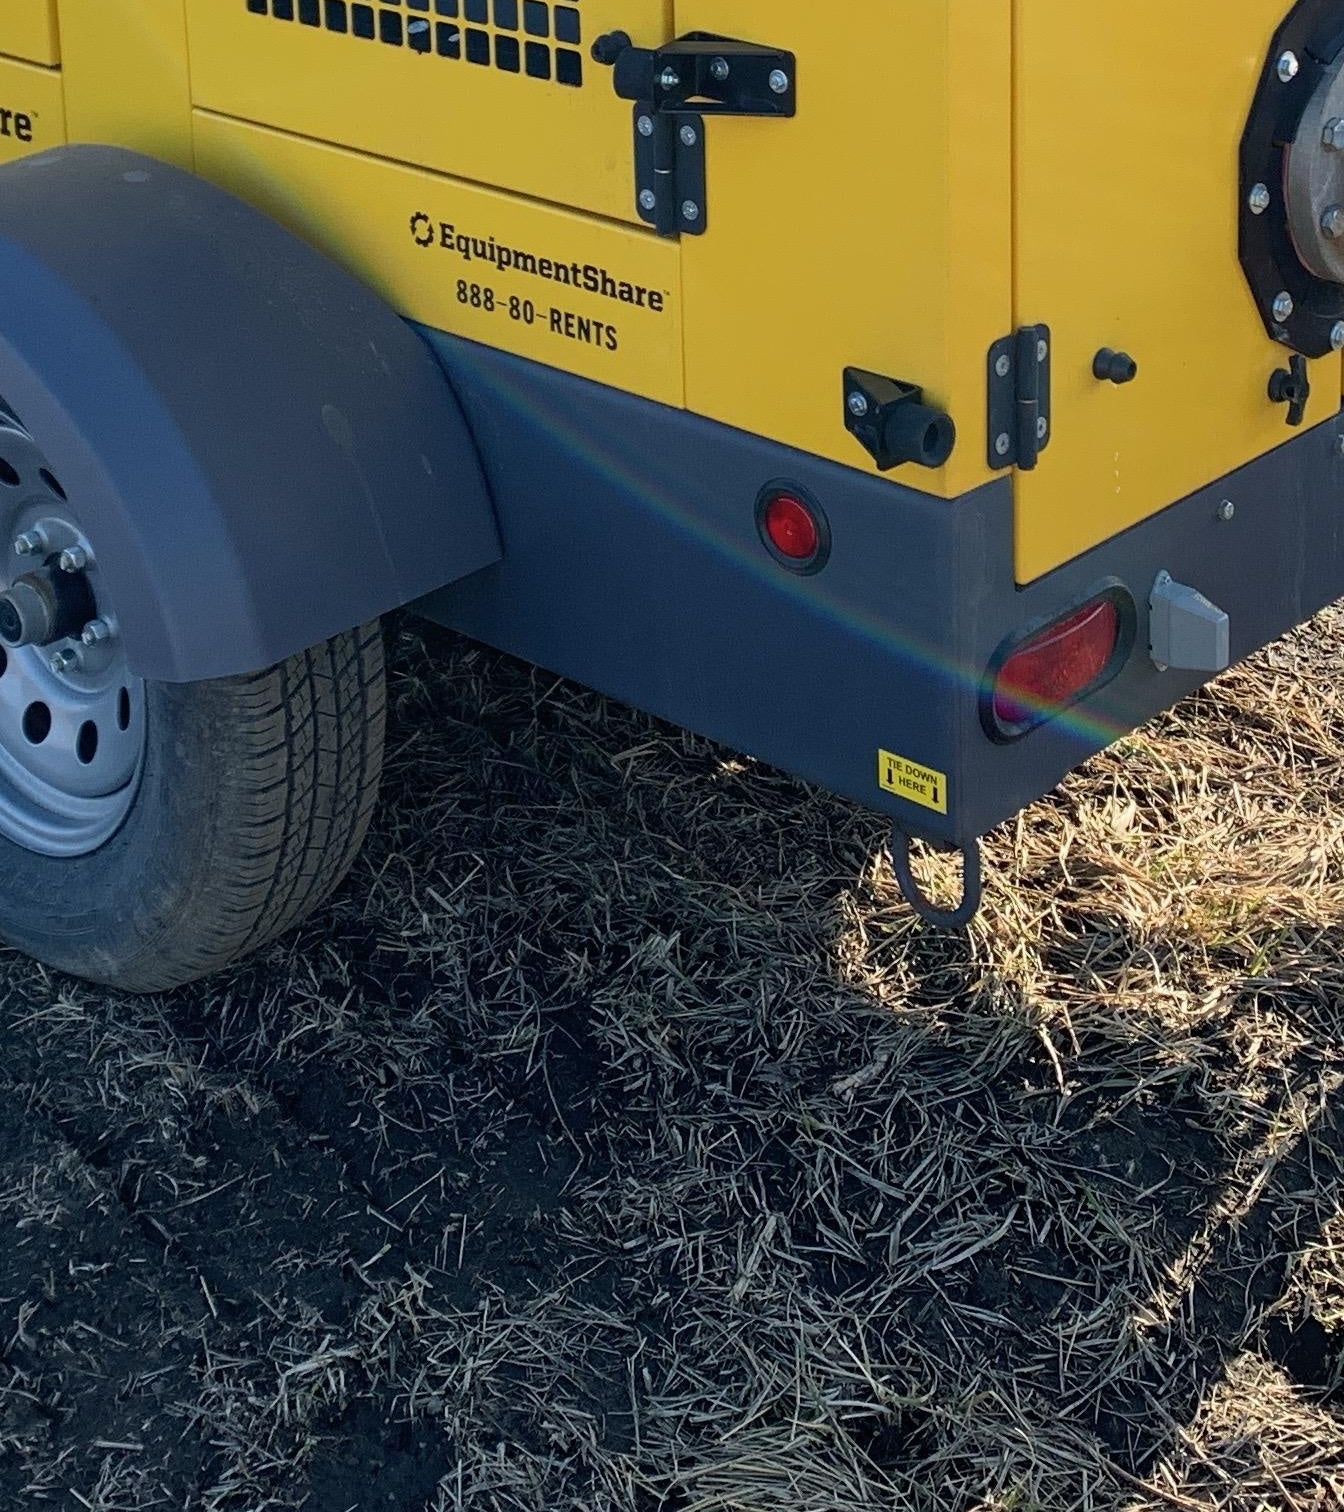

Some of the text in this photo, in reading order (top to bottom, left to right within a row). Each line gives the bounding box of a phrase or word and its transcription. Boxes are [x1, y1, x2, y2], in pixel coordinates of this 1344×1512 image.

[439, 222, 664, 313] EquipmentShare
[456, 279, 618, 351] 888-80-RENTS
[887, 756, 938, 786] TIE DOWN
[898, 775, 927, 796] HERE
